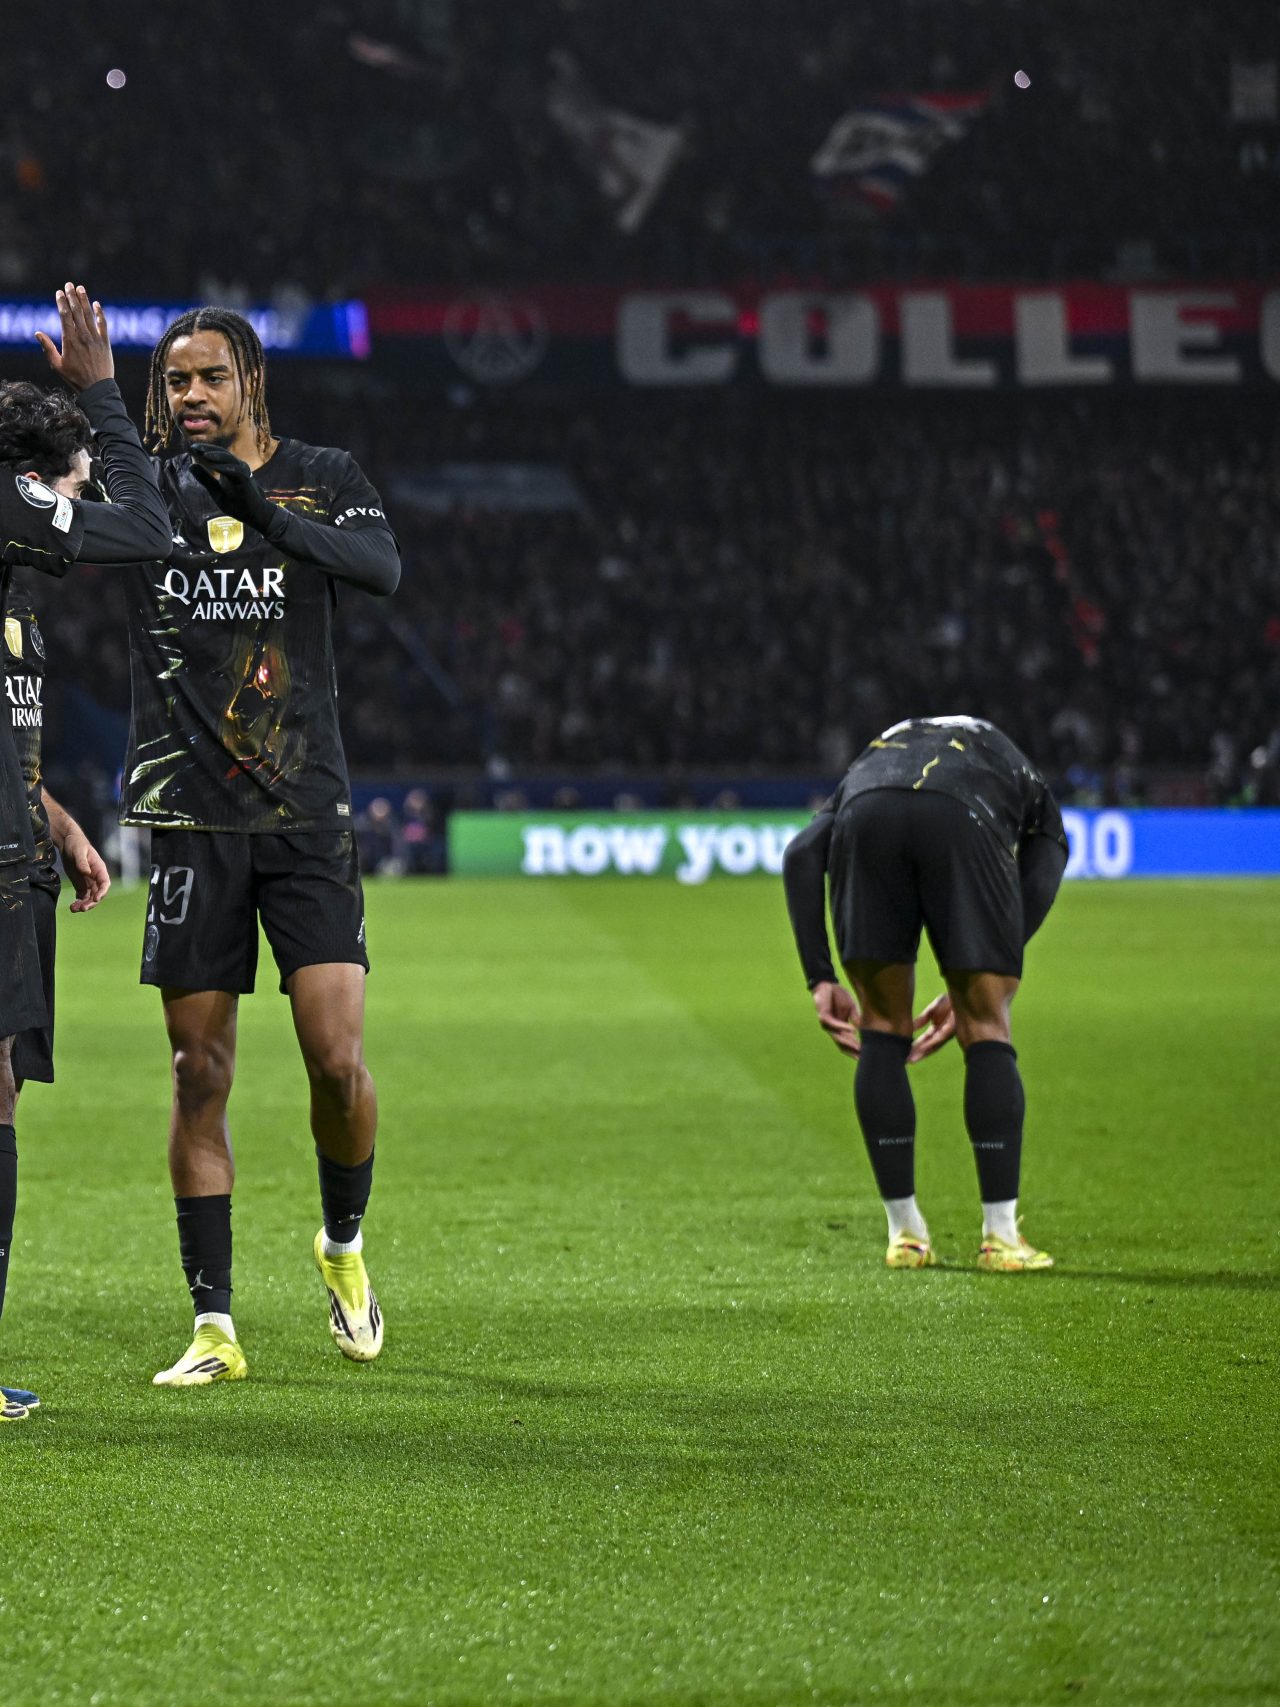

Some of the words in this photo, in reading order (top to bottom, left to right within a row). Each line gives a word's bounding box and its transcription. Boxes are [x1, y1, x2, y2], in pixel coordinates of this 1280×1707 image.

[618, 292, 1280, 386] COLLE
[164, 567, 286, 606] QATAR
[191, 601, 285, 620] AIRWAYS
[521, 822, 668, 876] now
